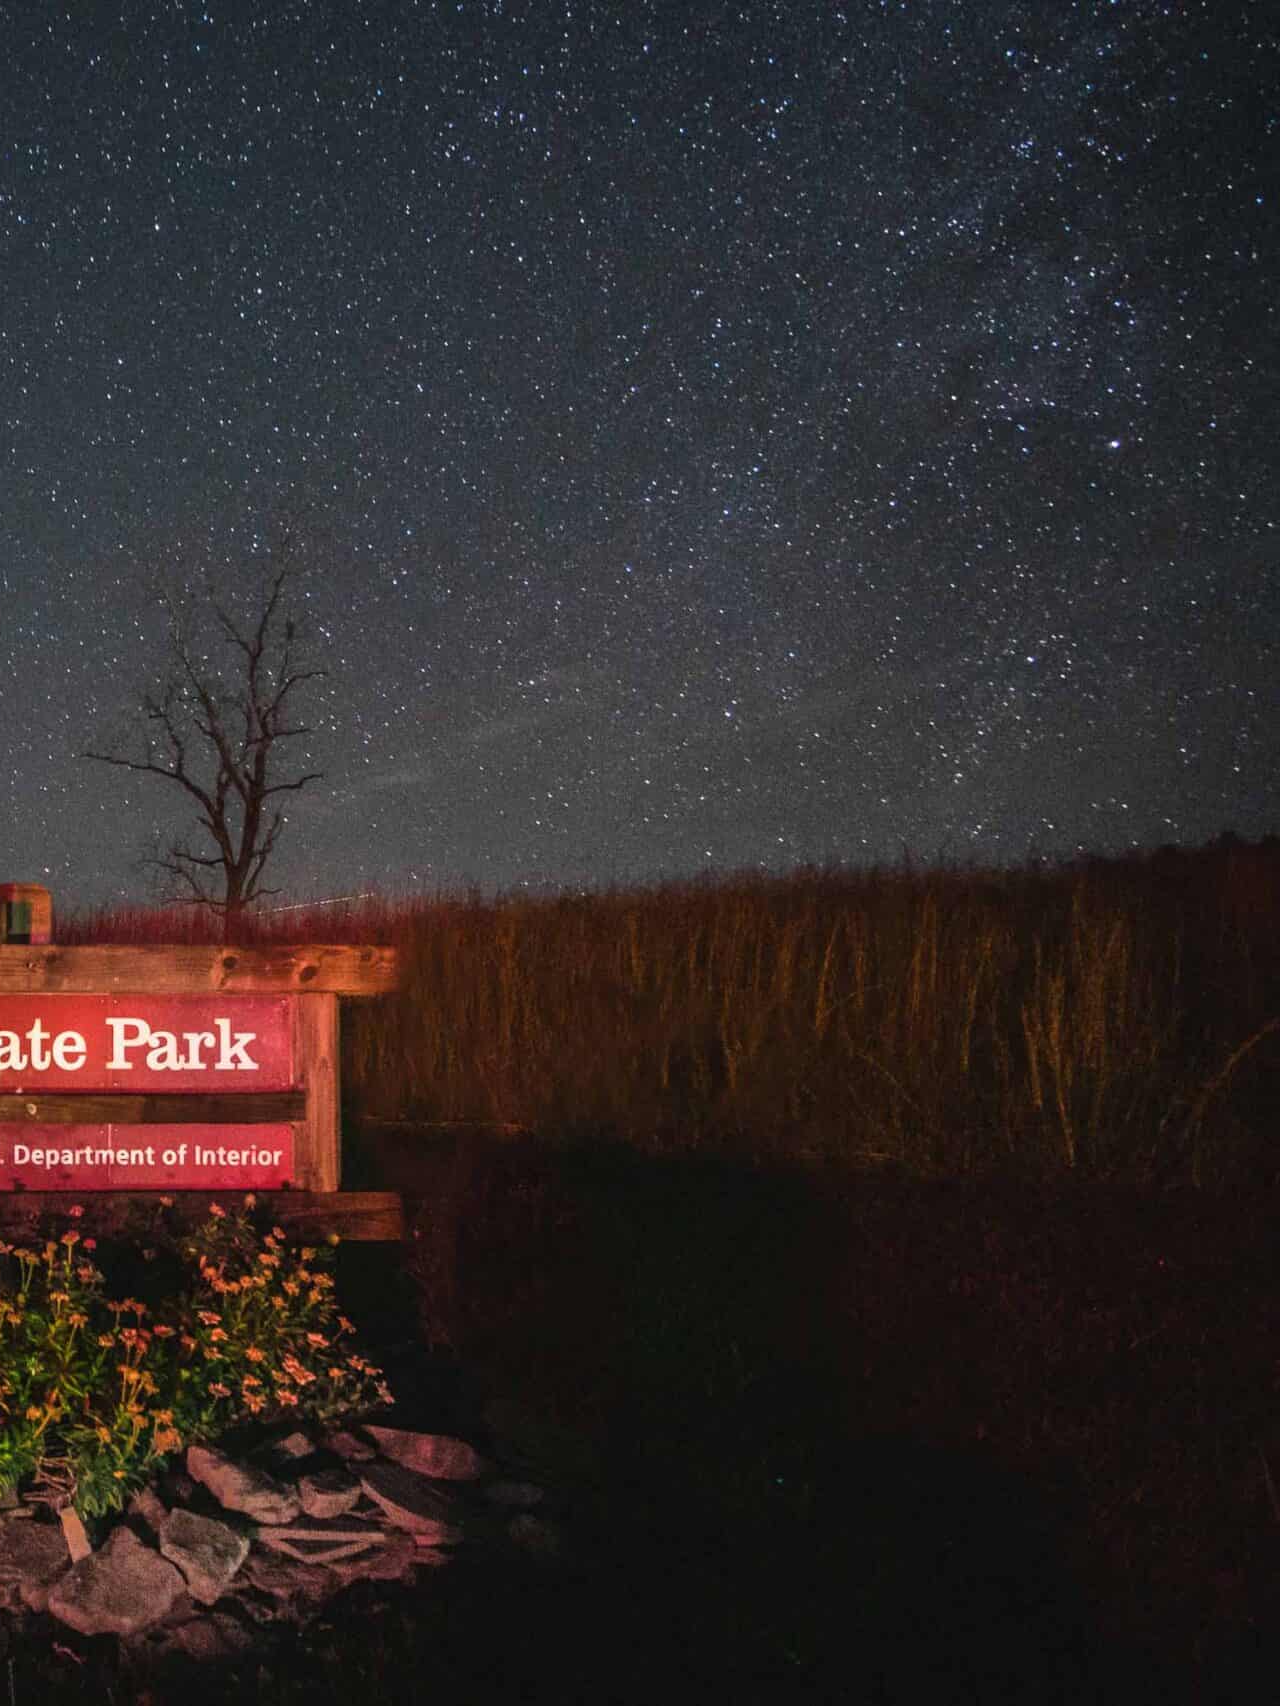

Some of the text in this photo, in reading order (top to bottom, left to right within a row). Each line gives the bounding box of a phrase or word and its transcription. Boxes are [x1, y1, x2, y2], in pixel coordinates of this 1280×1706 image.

[105, 1017, 259, 1071] Park
[14, 1144, 154, 1170] Department
[162, 1144, 188, 1166] of
[194, 1144, 283, 1166] Interior
